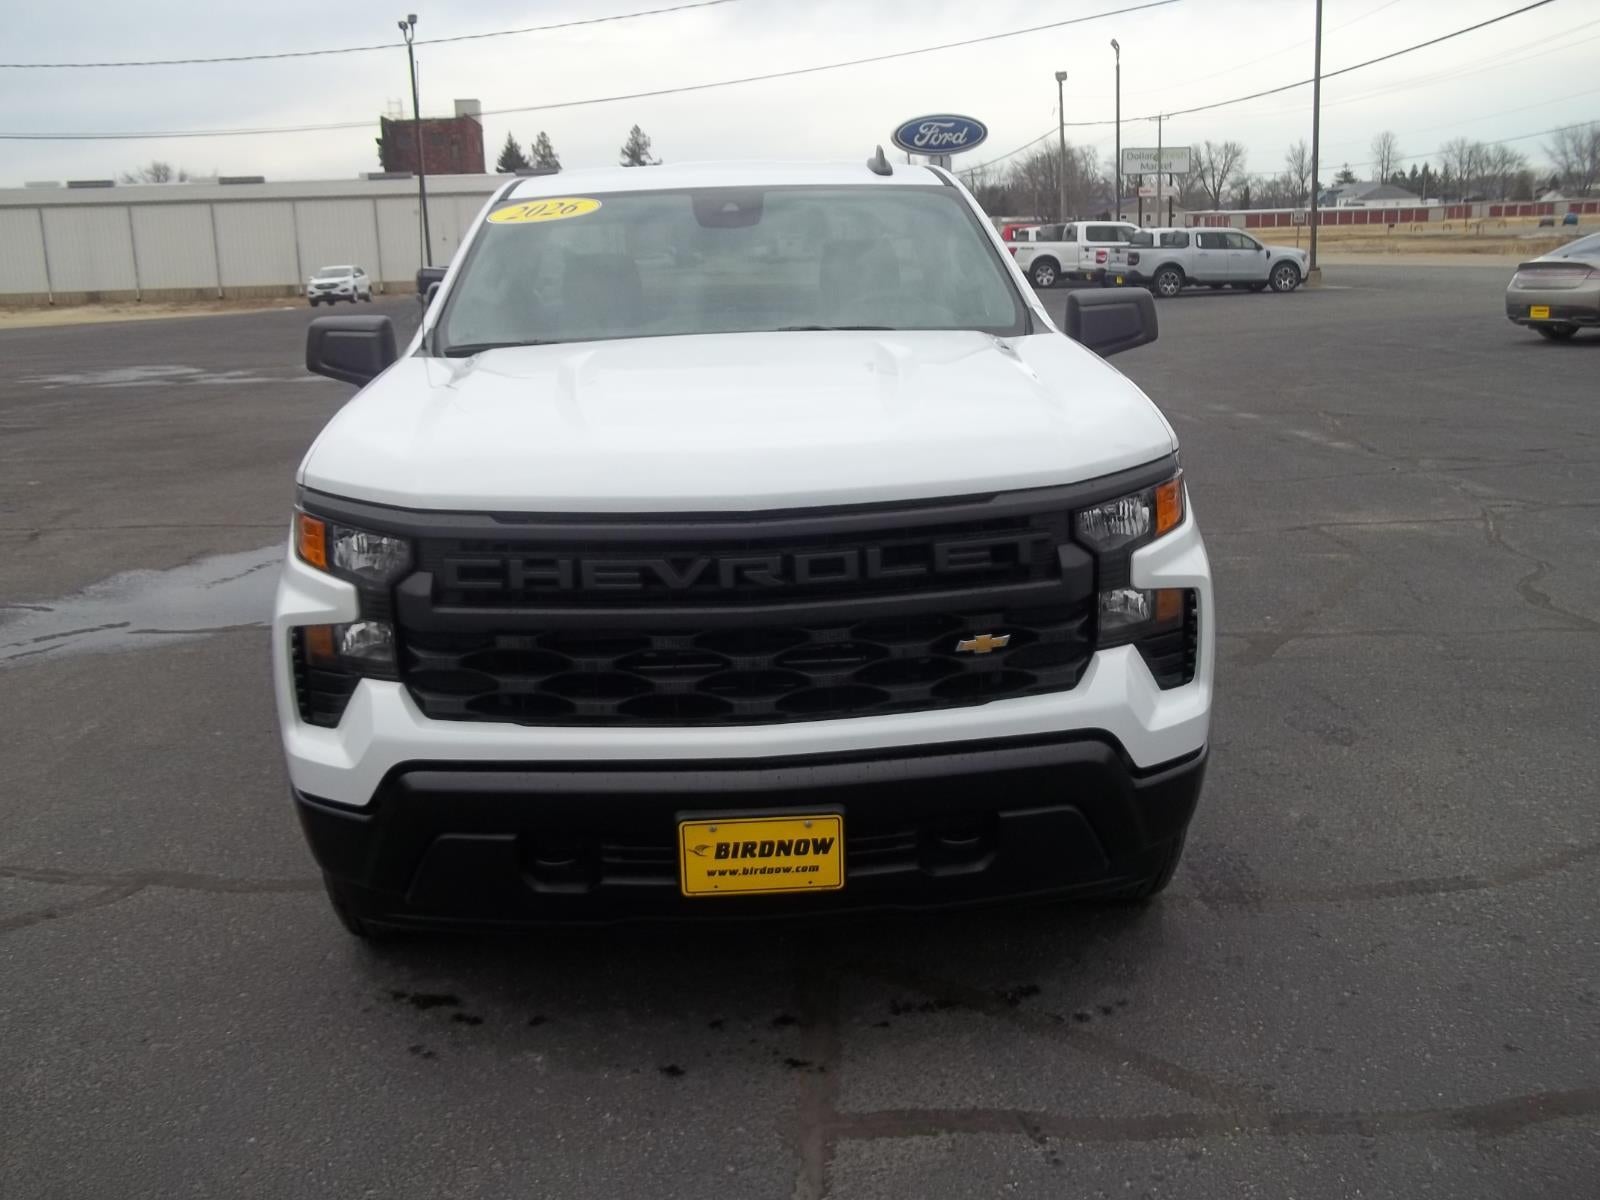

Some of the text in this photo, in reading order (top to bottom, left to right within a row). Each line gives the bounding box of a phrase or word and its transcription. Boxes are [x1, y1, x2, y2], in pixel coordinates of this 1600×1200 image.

[914, 122, 968, 147] Ford
[1126, 151, 1153, 161] Dollar
[506, 201, 582, 219] 2026
[445, 532, 1050, 591] CHEVROLET
[715, 838, 835, 859] BIRDNOW
[707, 865, 819, 877] www.birdnow.com
